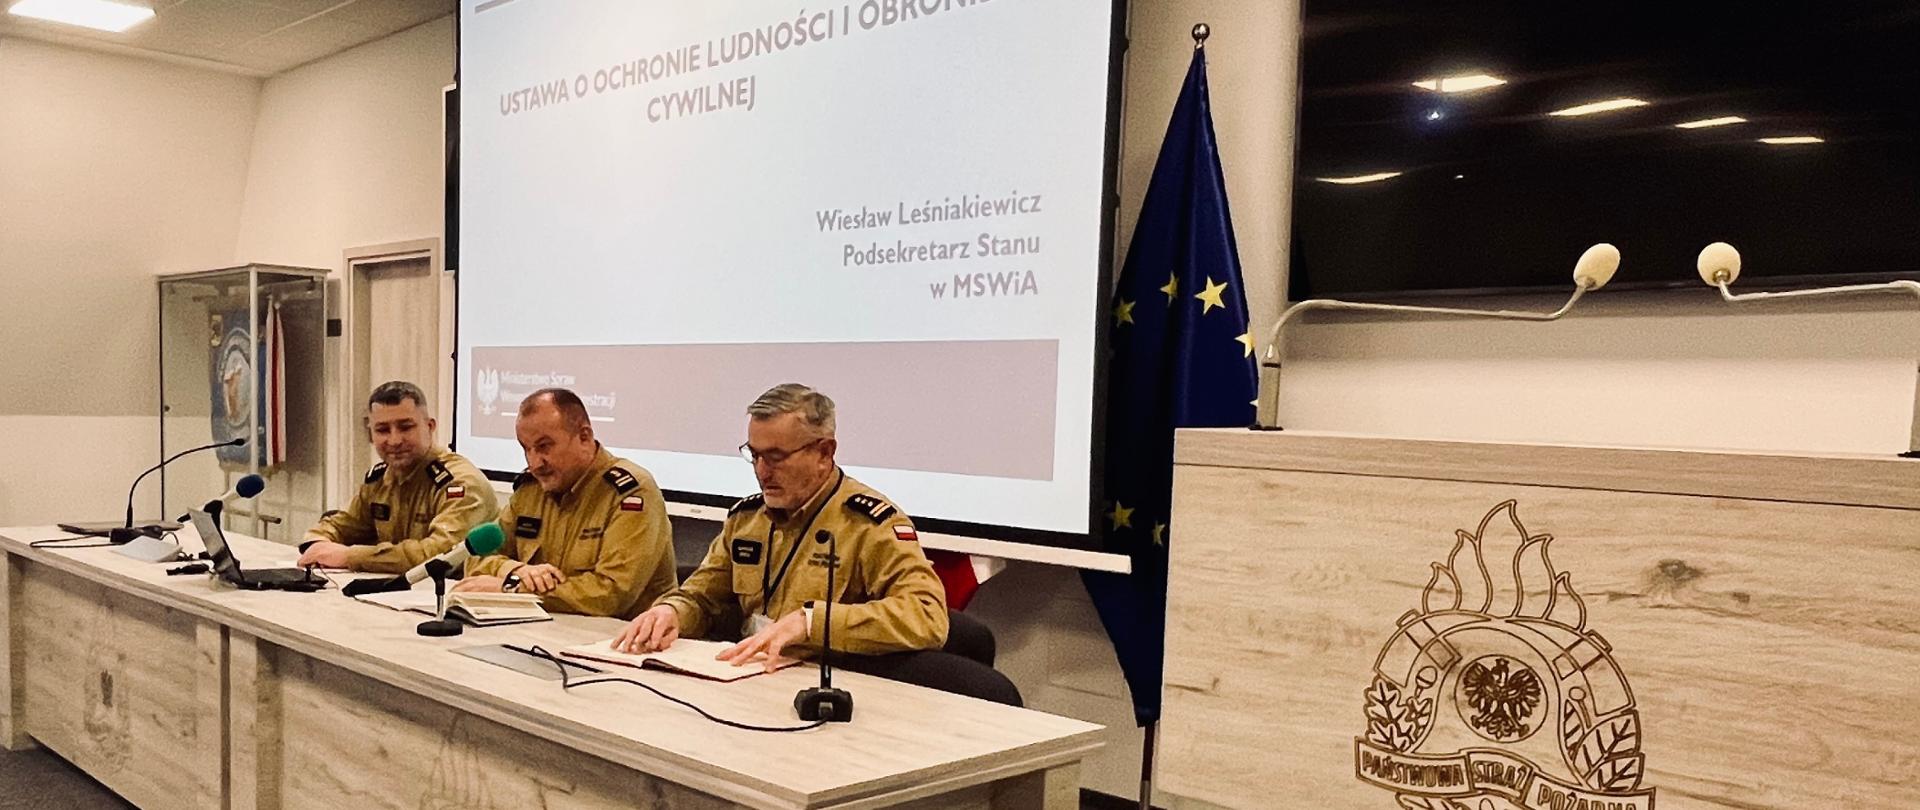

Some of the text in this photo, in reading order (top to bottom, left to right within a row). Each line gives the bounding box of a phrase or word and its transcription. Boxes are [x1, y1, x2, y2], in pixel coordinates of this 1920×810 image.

[500, 79, 569, 116] USTAWA
[574, 74, 588, 98] O
[594, 44, 700, 94] OCHRONIE
[707, 9, 833, 68] LUDNOŚCI
[843, 6, 849, 36] I
[647, 75, 755, 122] CYWILNEJ
[816, 190, 1042, 232] Wiesław Leśniakiewicz
[843, 232, 1040, 266] Podsekretarz Stanu
[930, 270, 1039, 299] w MSWiA
